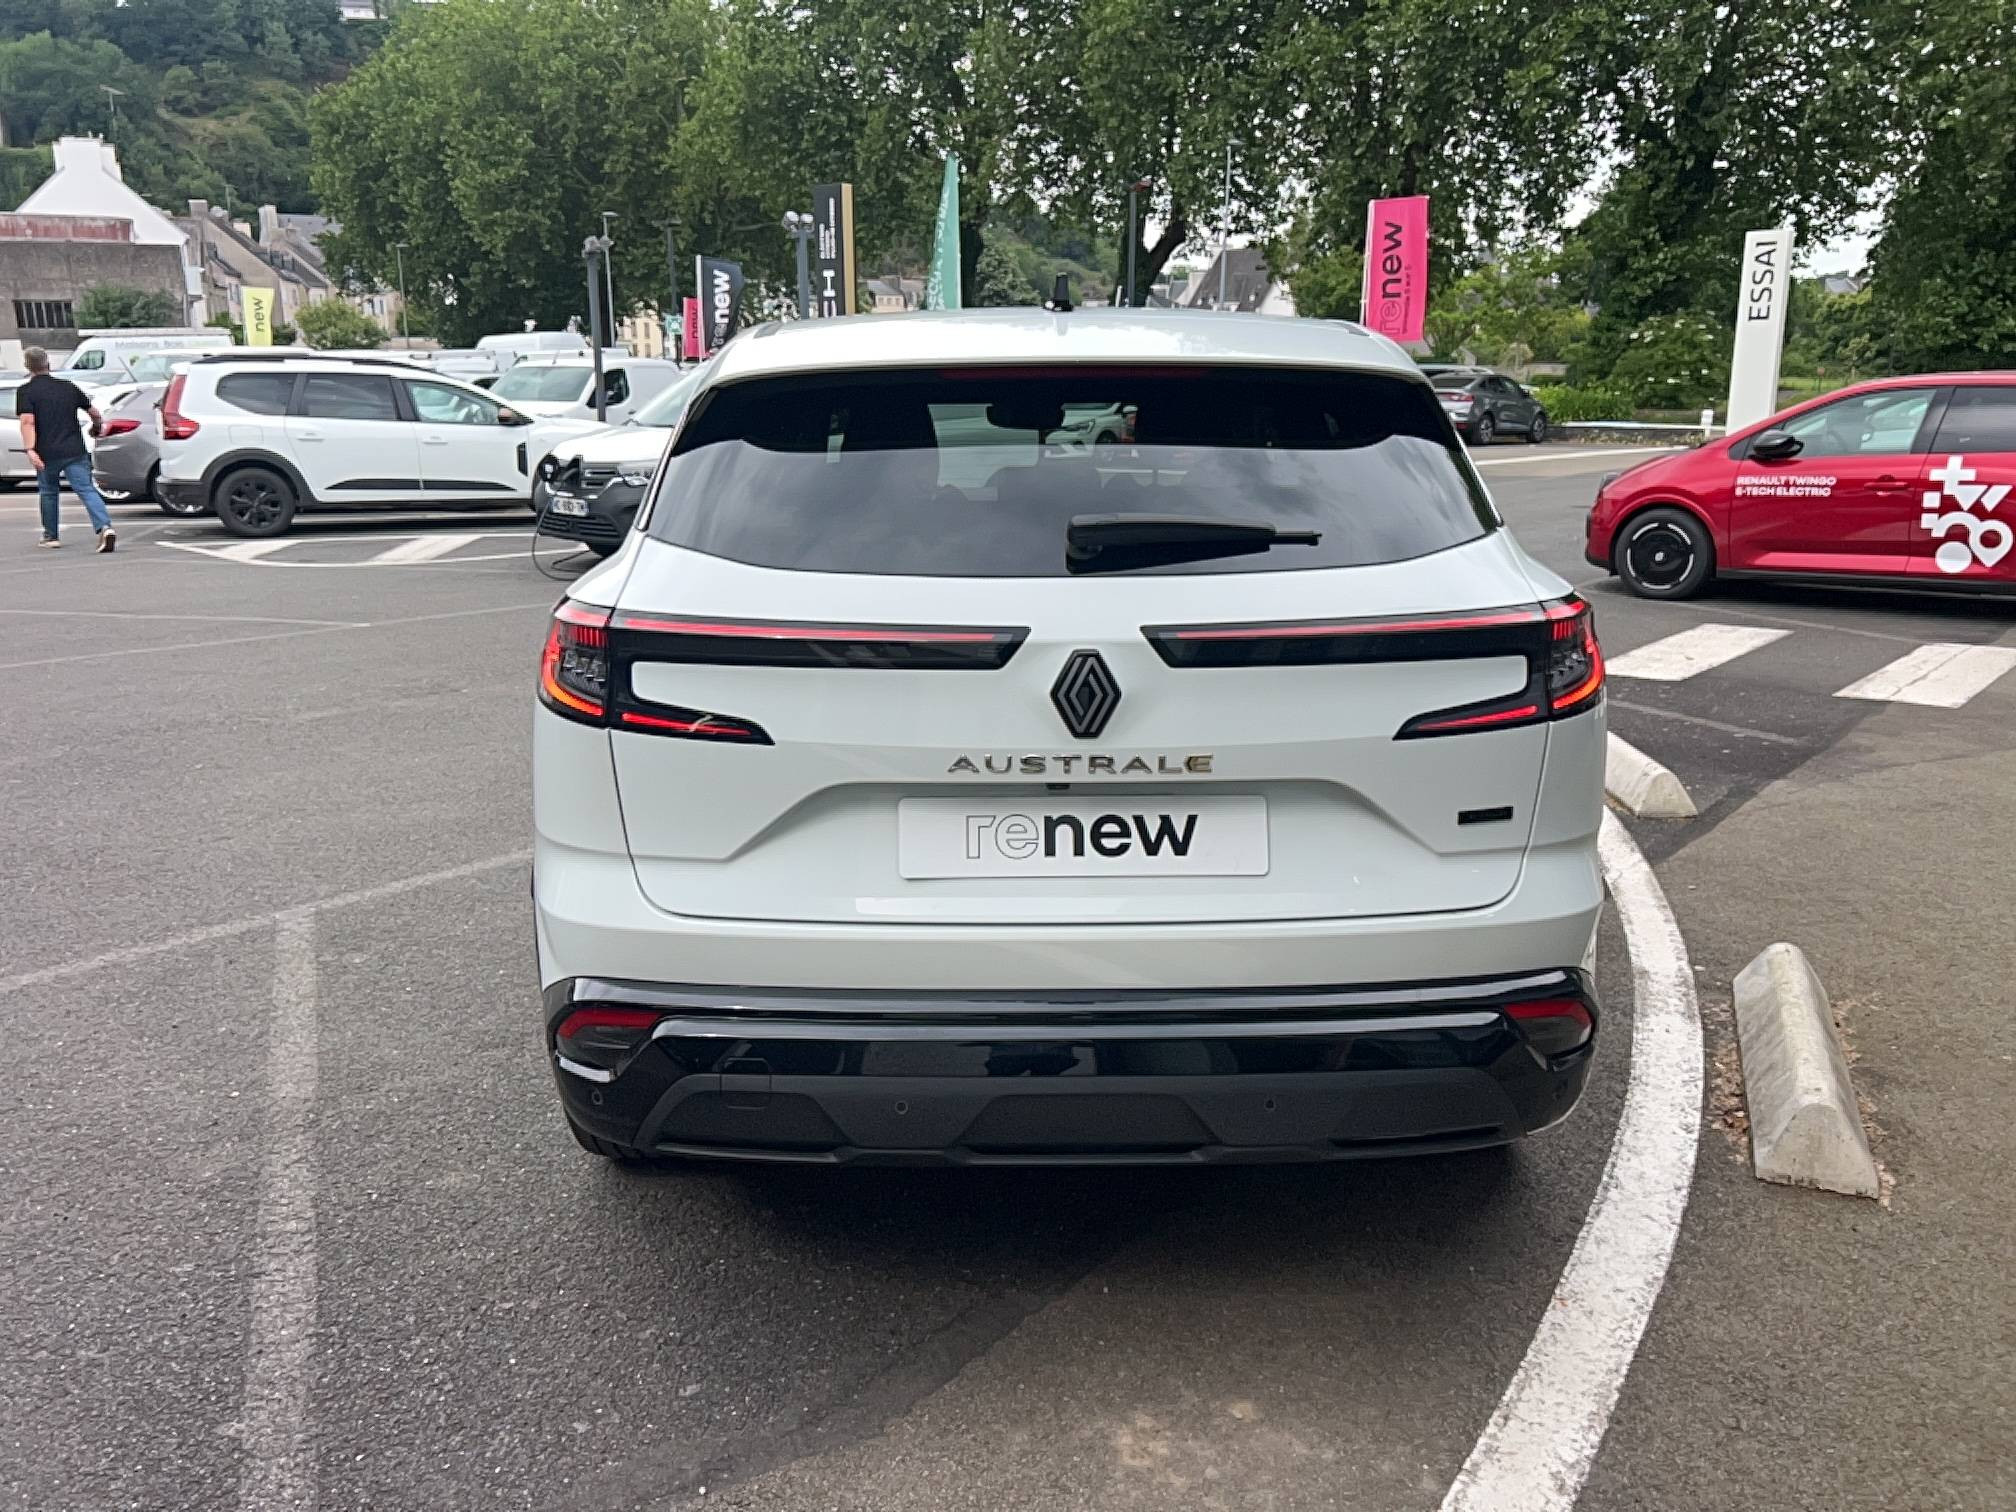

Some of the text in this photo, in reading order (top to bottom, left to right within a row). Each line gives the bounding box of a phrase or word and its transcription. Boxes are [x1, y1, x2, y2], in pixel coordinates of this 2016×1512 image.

[1380, 221, 1403, 335] renew
[1748, 241, 1777, 321] ESSAI
[1735, 486, 1831, 496] E-TECH ELECTRIC
[1736, 476, 1837, 486] RENAULT TWINGO
[966, 814, 1197, 860] renew
